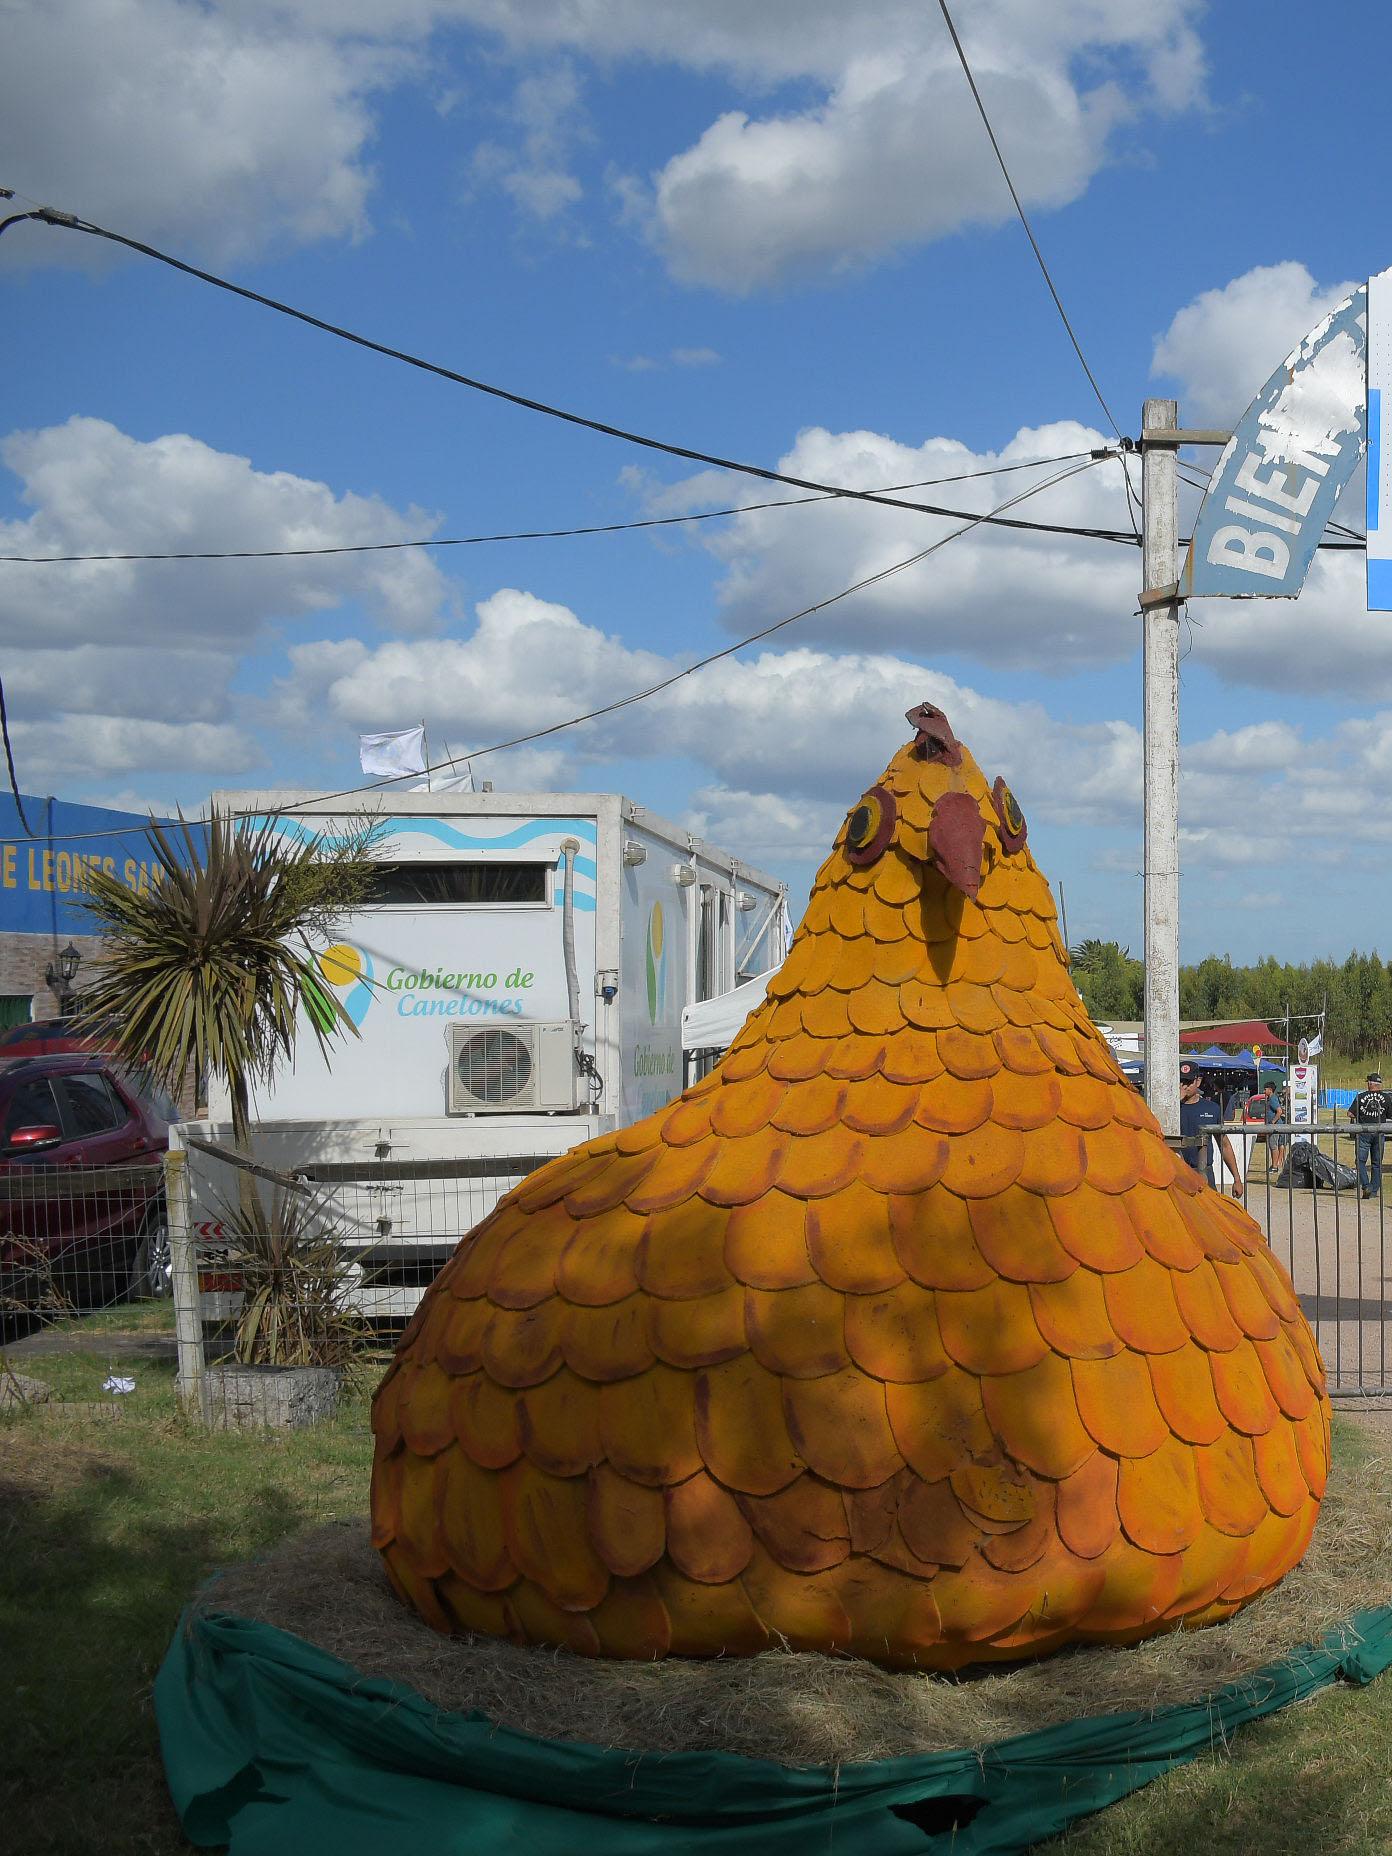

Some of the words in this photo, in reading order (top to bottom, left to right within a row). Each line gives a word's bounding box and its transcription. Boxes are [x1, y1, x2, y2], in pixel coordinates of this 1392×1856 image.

[0, 845, 17, 888] E
[386, 967, 498, 990] Gobierno
[505, 967, 535, 989] de
[397, 993, 524, 1017] Canelones
